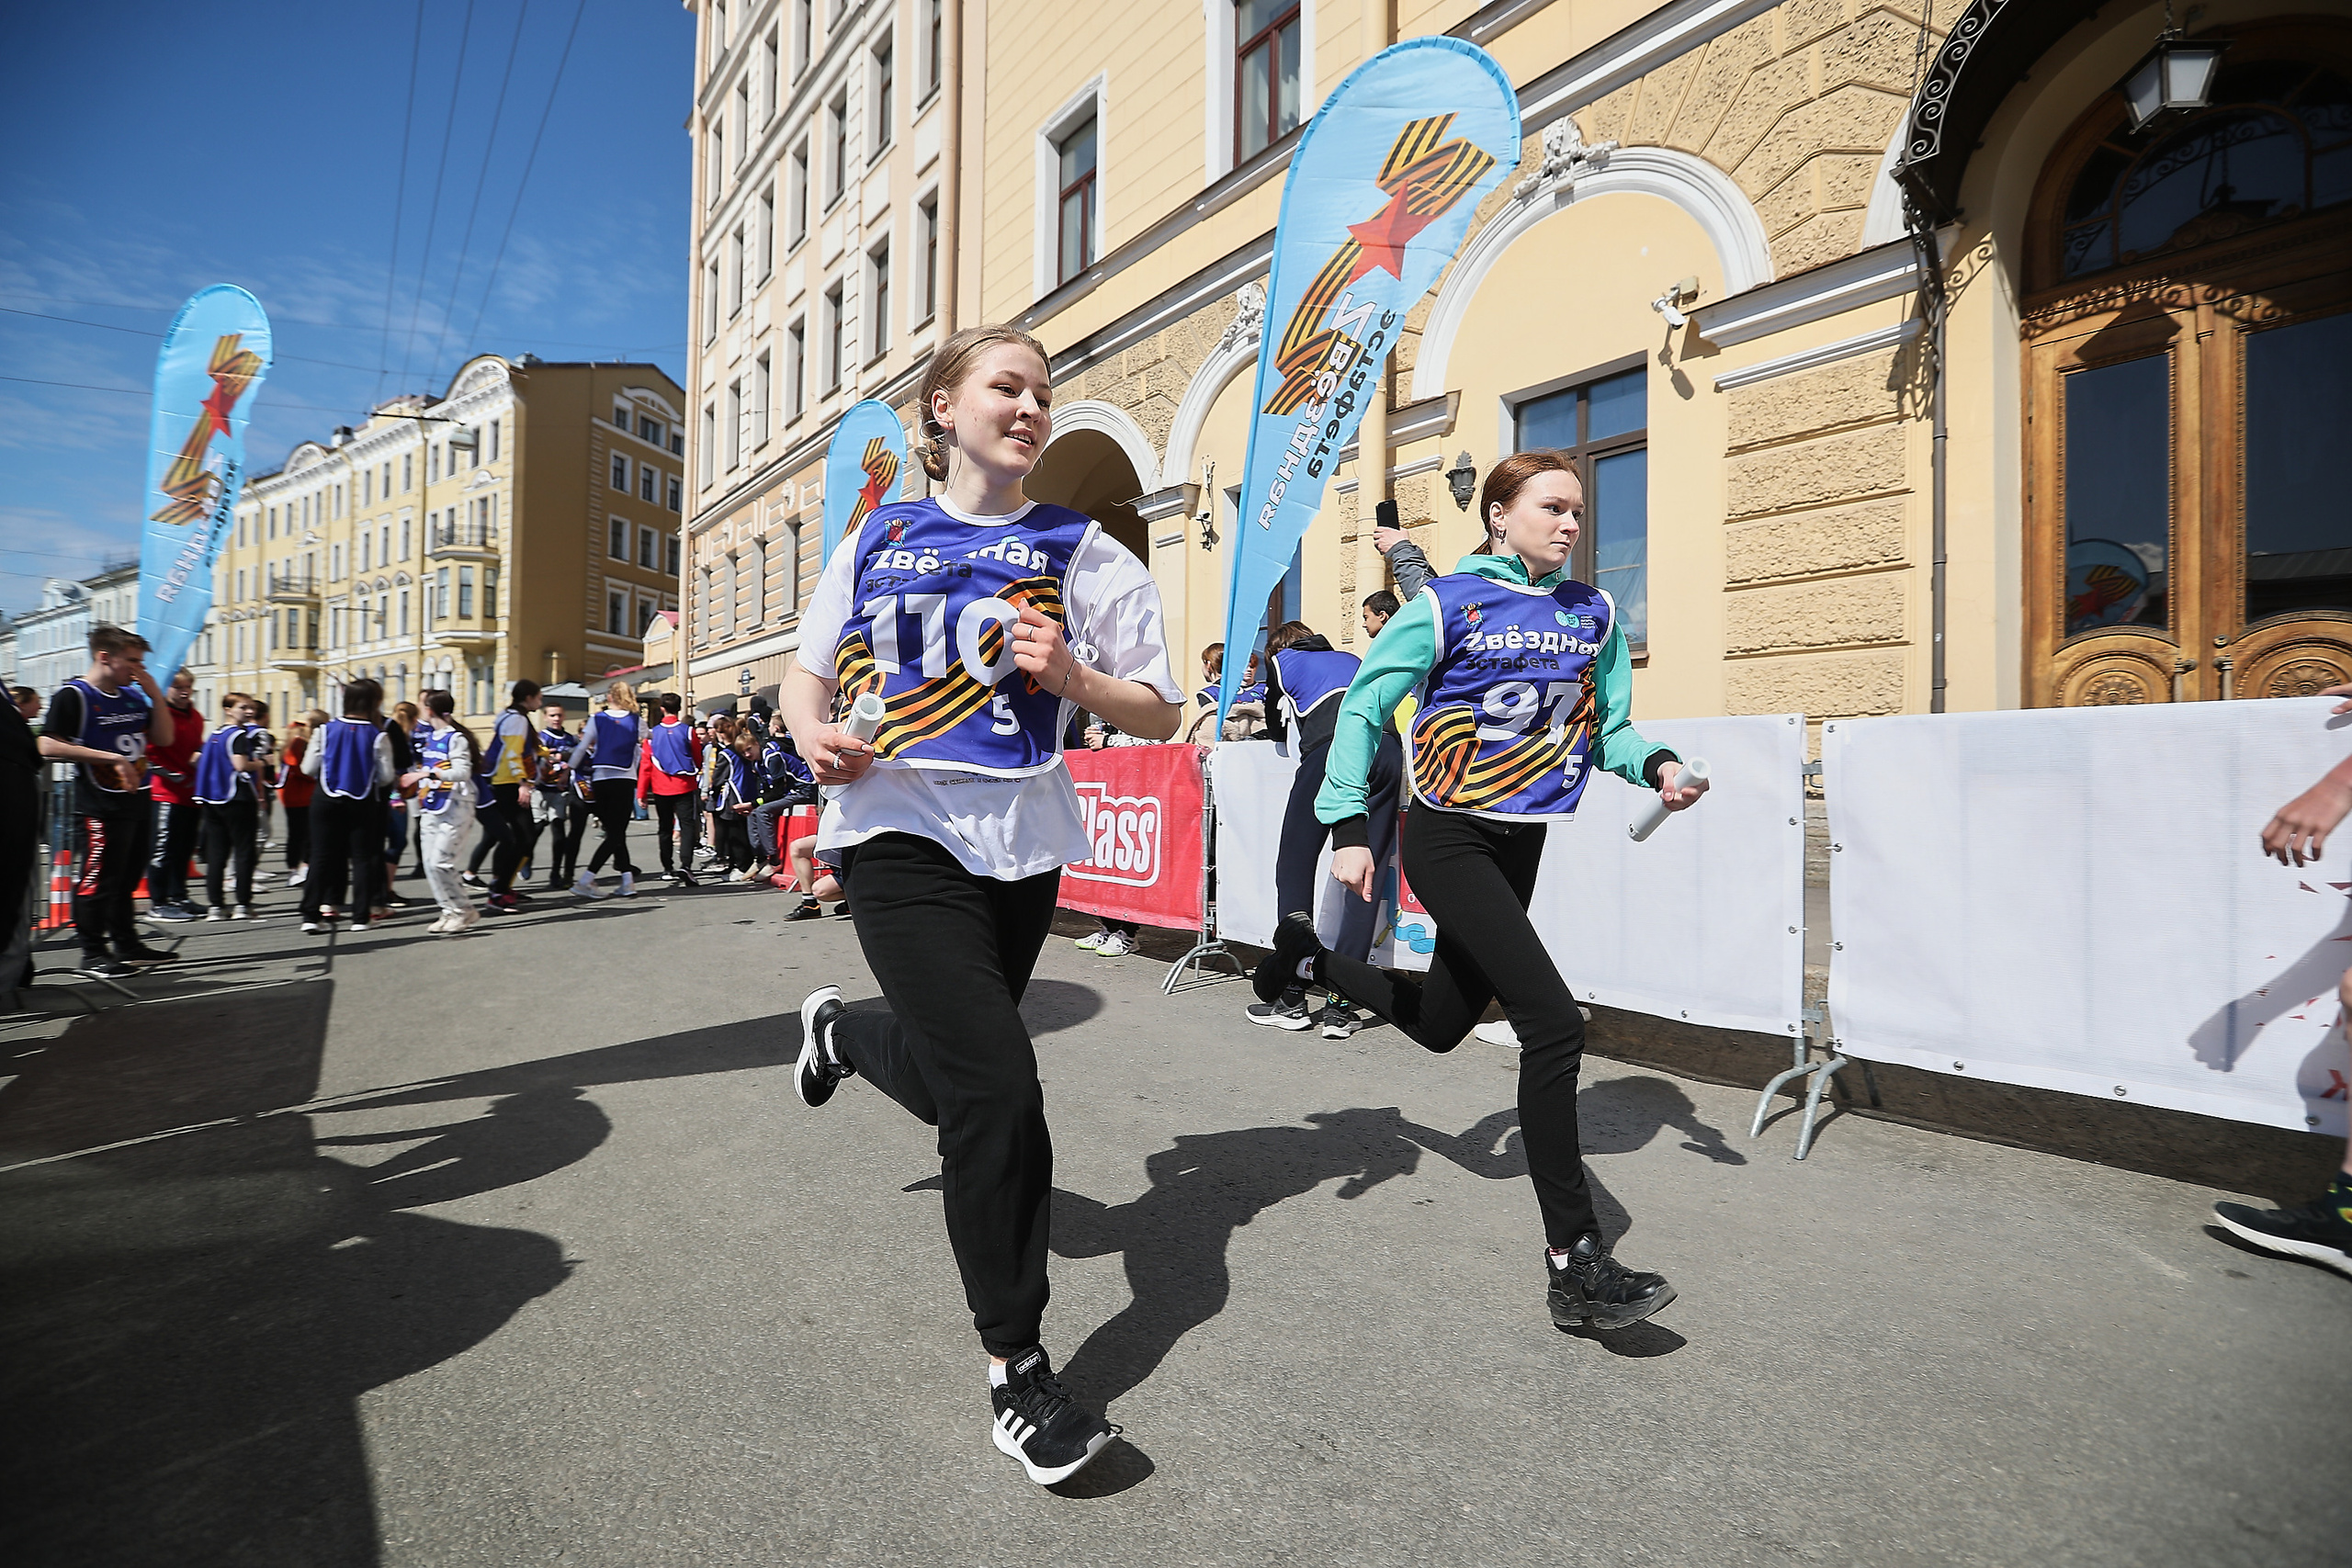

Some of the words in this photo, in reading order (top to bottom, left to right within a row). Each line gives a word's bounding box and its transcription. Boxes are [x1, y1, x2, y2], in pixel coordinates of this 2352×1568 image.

[871, 542, 1050, 575] Zвёная
[865, 562, 973, 593] эстета
[862, 594, 1021, 687] 110
[1464, 653, 1560, 673] эстафета
[990, 693, 1021, 736] 5
[1476, 682, 1584, 747] 97
[1562, 754, 1584, 789] 5
